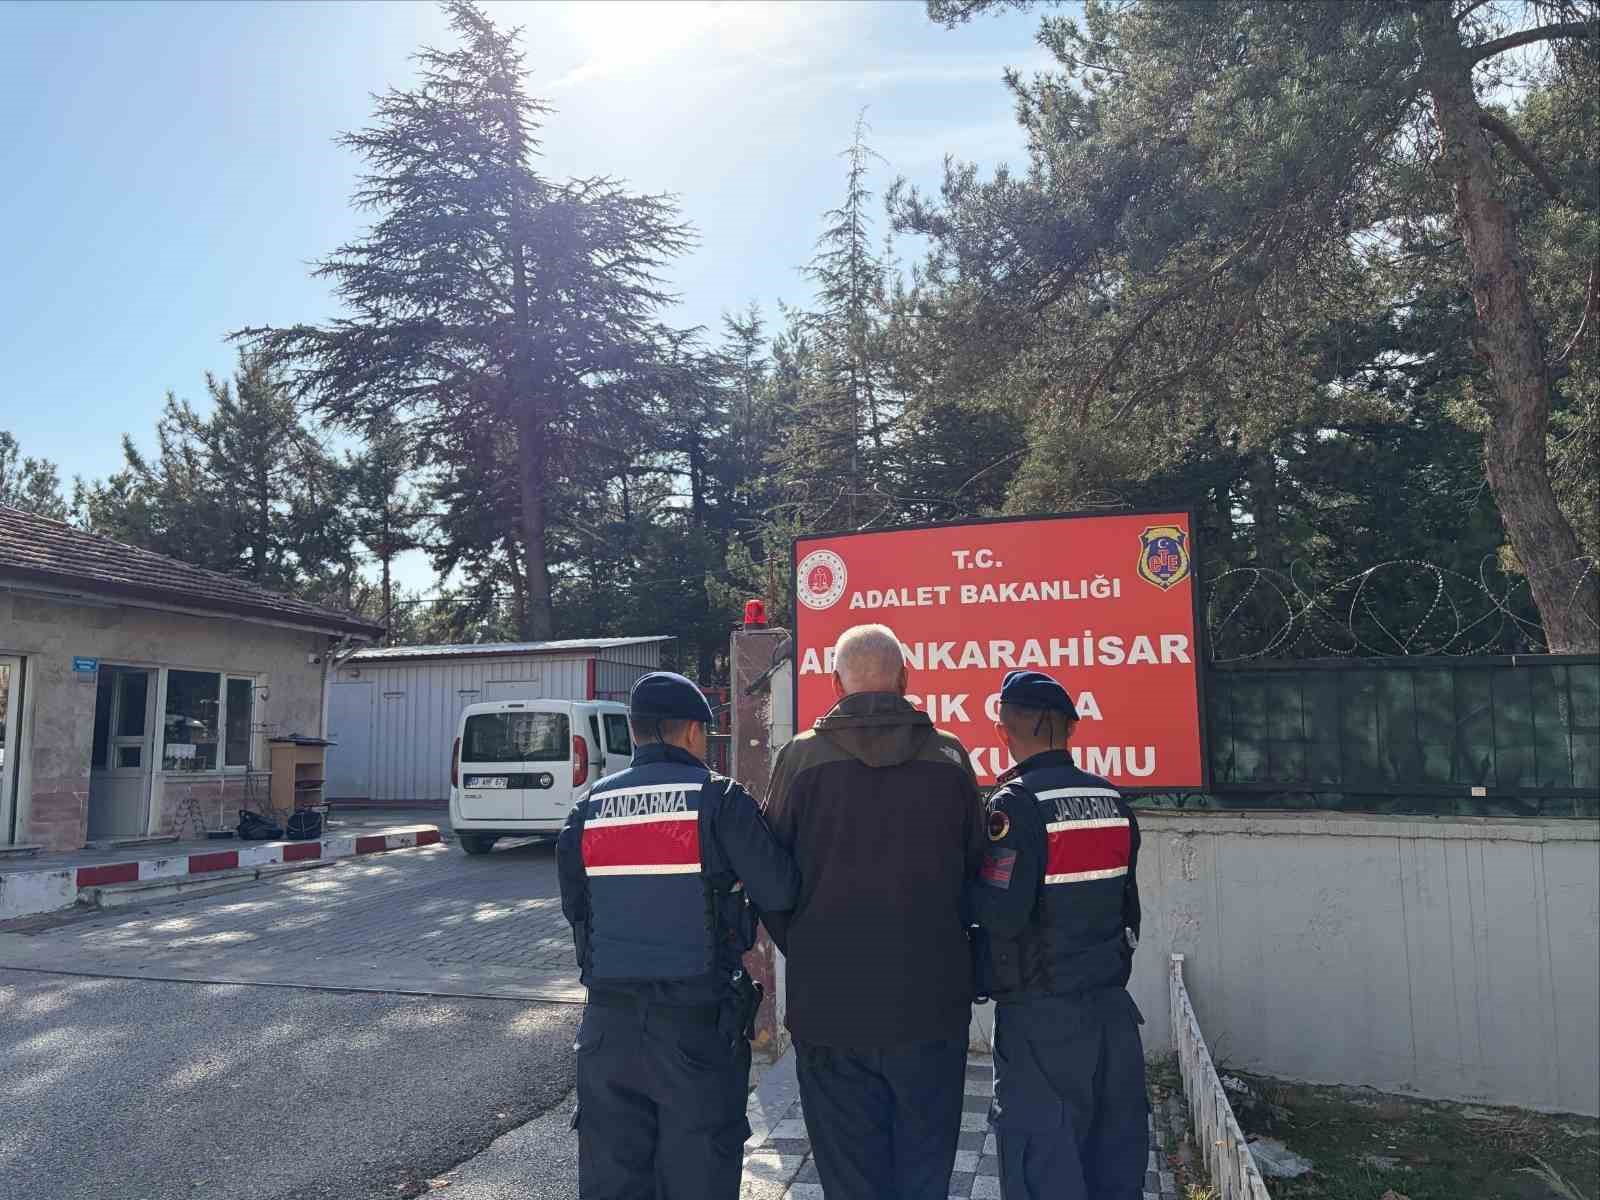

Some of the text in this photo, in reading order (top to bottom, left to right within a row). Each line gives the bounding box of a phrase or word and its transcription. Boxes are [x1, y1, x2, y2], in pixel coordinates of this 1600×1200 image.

[952, 549, 1004, 570] T.C.
[849, 574, 1121, 610] ADALET BAKANLIĞI
[799, 629, 1193, 676] AFNKARAHİSAR
[596, 791, 688, 818] JANDARMA
[1055, 797, 1121, 821] JANDARMA
